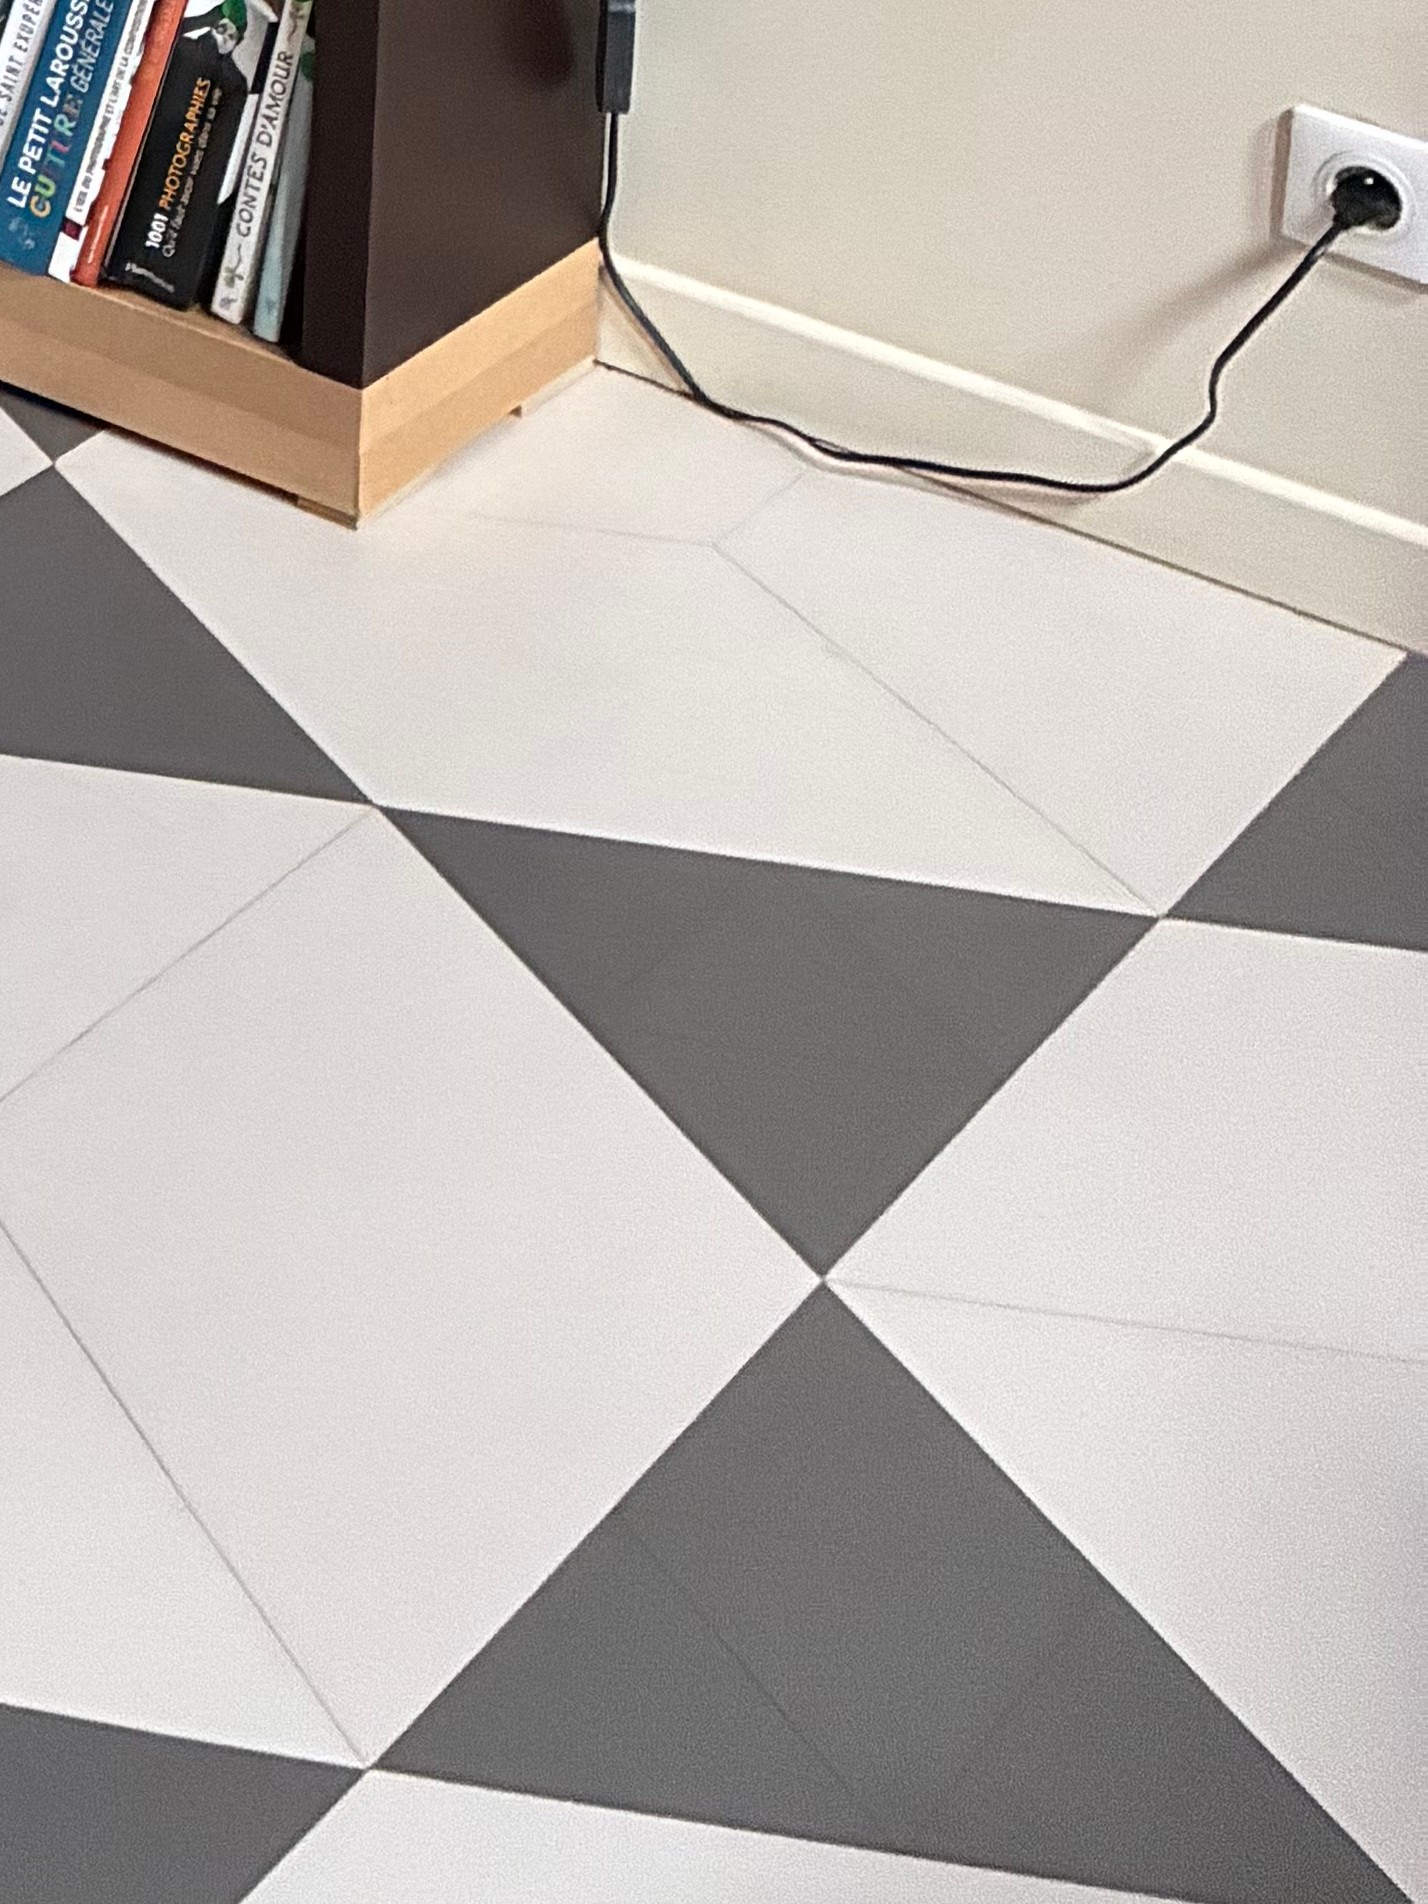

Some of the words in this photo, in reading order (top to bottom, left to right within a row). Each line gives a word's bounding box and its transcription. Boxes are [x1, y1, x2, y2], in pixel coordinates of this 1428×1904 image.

[6, 178, 30, 208] LE
[15, 107, 53, 173] PETIT
[144, 212, 169, 250] 1001
[158, 76, 212, 210] PHOTOGRAPHIES
[234, 151, 268, 239] CONTES
[253, 48, 294, 148] D'AMOUR
